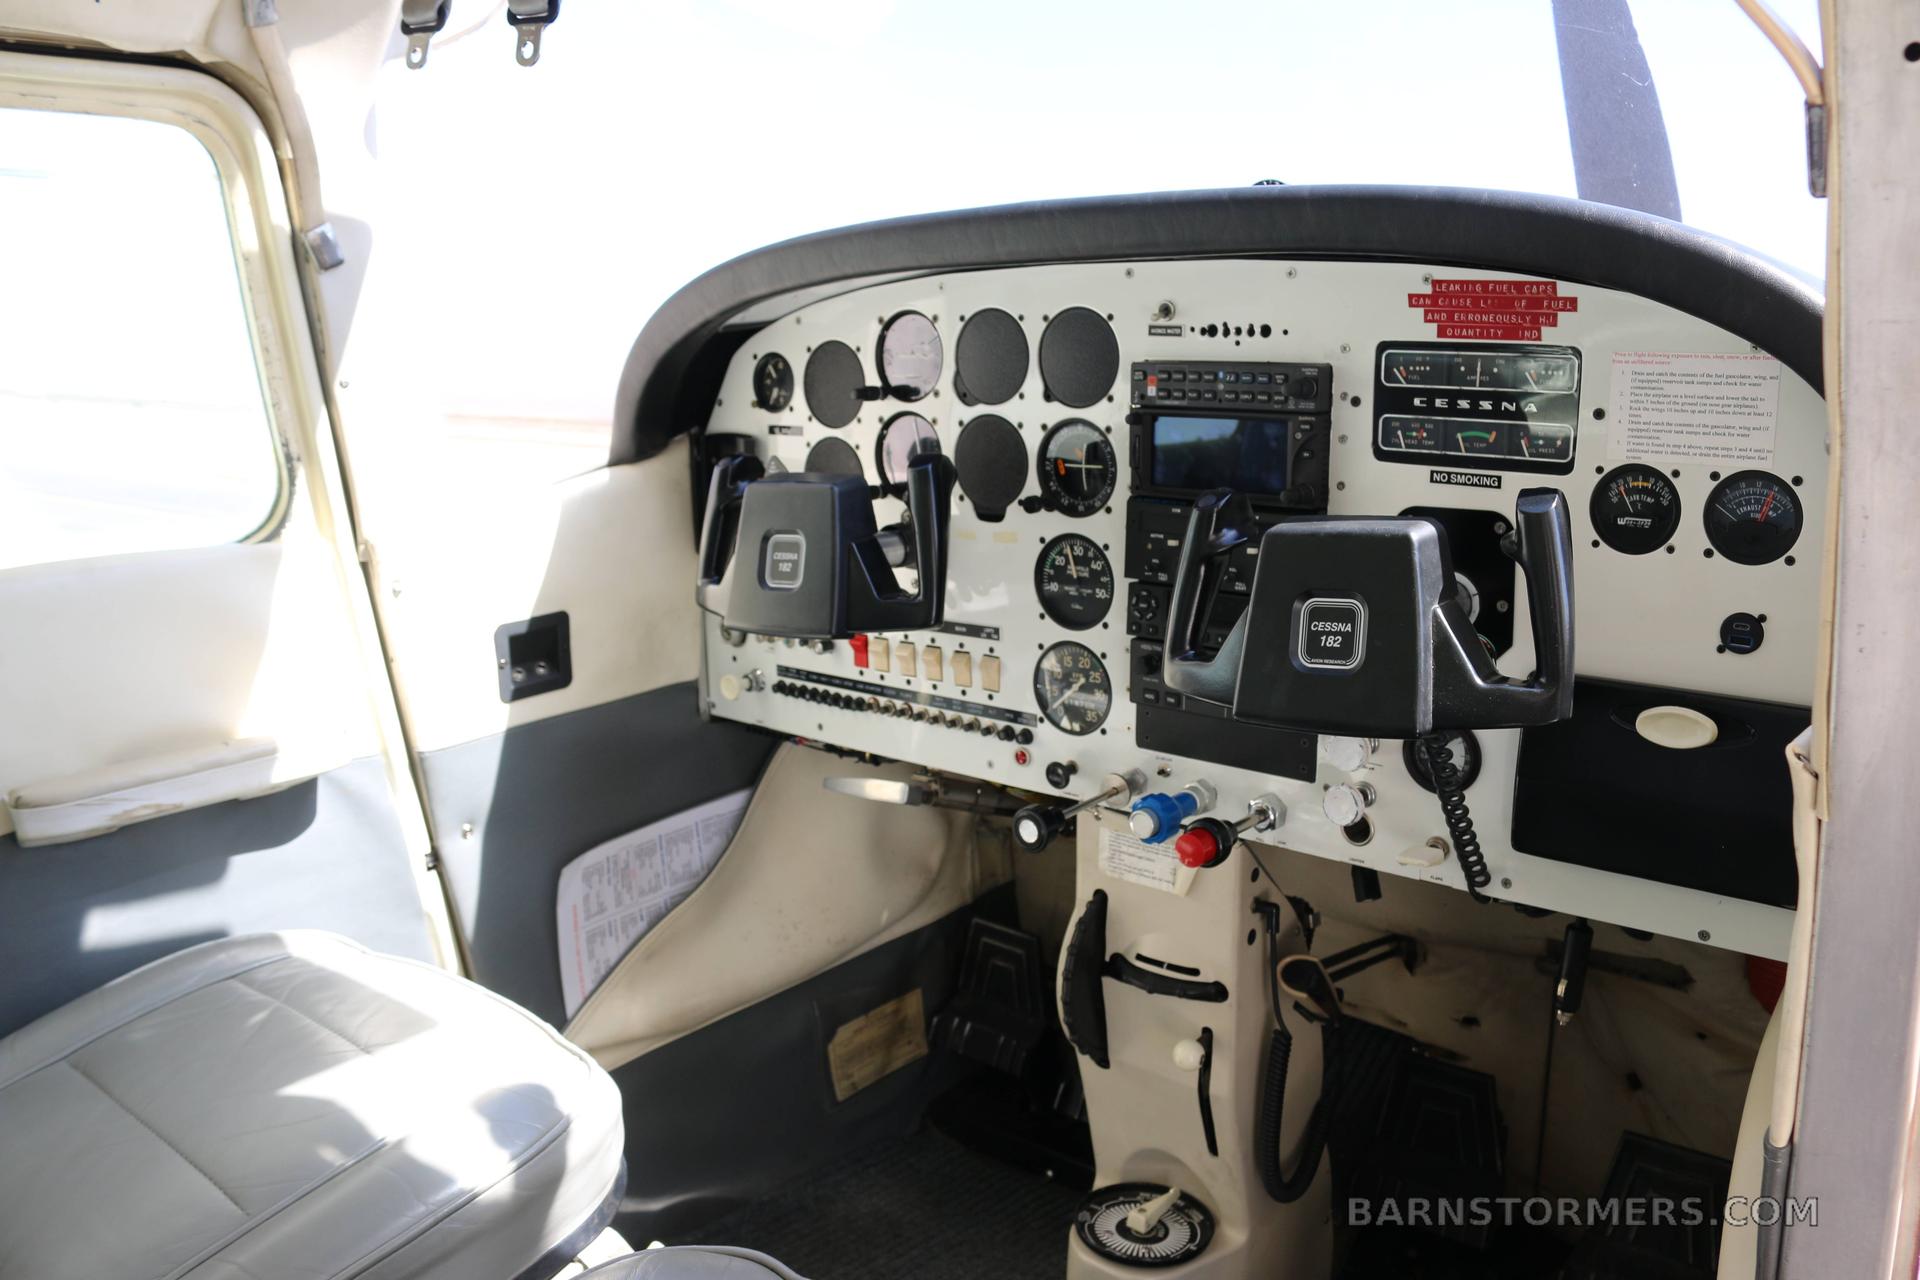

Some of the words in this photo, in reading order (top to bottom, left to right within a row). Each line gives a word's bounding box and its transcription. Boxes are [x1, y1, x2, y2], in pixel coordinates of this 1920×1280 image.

[1489, 285, 1516, 293] FUEL
[1524, 286, 1553, 294] CAPS
[1412, 297, 1431, 305] CAN
[1543, 301, 1573, 309] FUEL
[1427, 312, 1447, 321] AND
[1454, 313, 1532, 324] ERRONEOUSLY
[1446, 328, 1503, 337] QUANTITY
[1519, 329, 1539, 339] IND
[1413, 397, 1538, 413] CESSNA
[1432, 472, 1448, 483] NO
[1450, 474, 1499, 487] SMOKING
[773, 552, 798, 561] CESSNA
[1073, 545, 1084, 556] 30
[1055, 555, 1066, 566] 20
[1090, 560, 1102, 571] 40
[778, 563, 792, 572] 182
[1095, 588, 1106, 599] 50
[1310, 621, 1352, 633] CESSNA
[1320, 635, 1342, 648] 182
[1063, 656, 1073, 668] 15
[1079, 656, 1090, 669] 20
[1088, 671, 1101, 683] 25
[1086, 710, 1098, 722] 35
